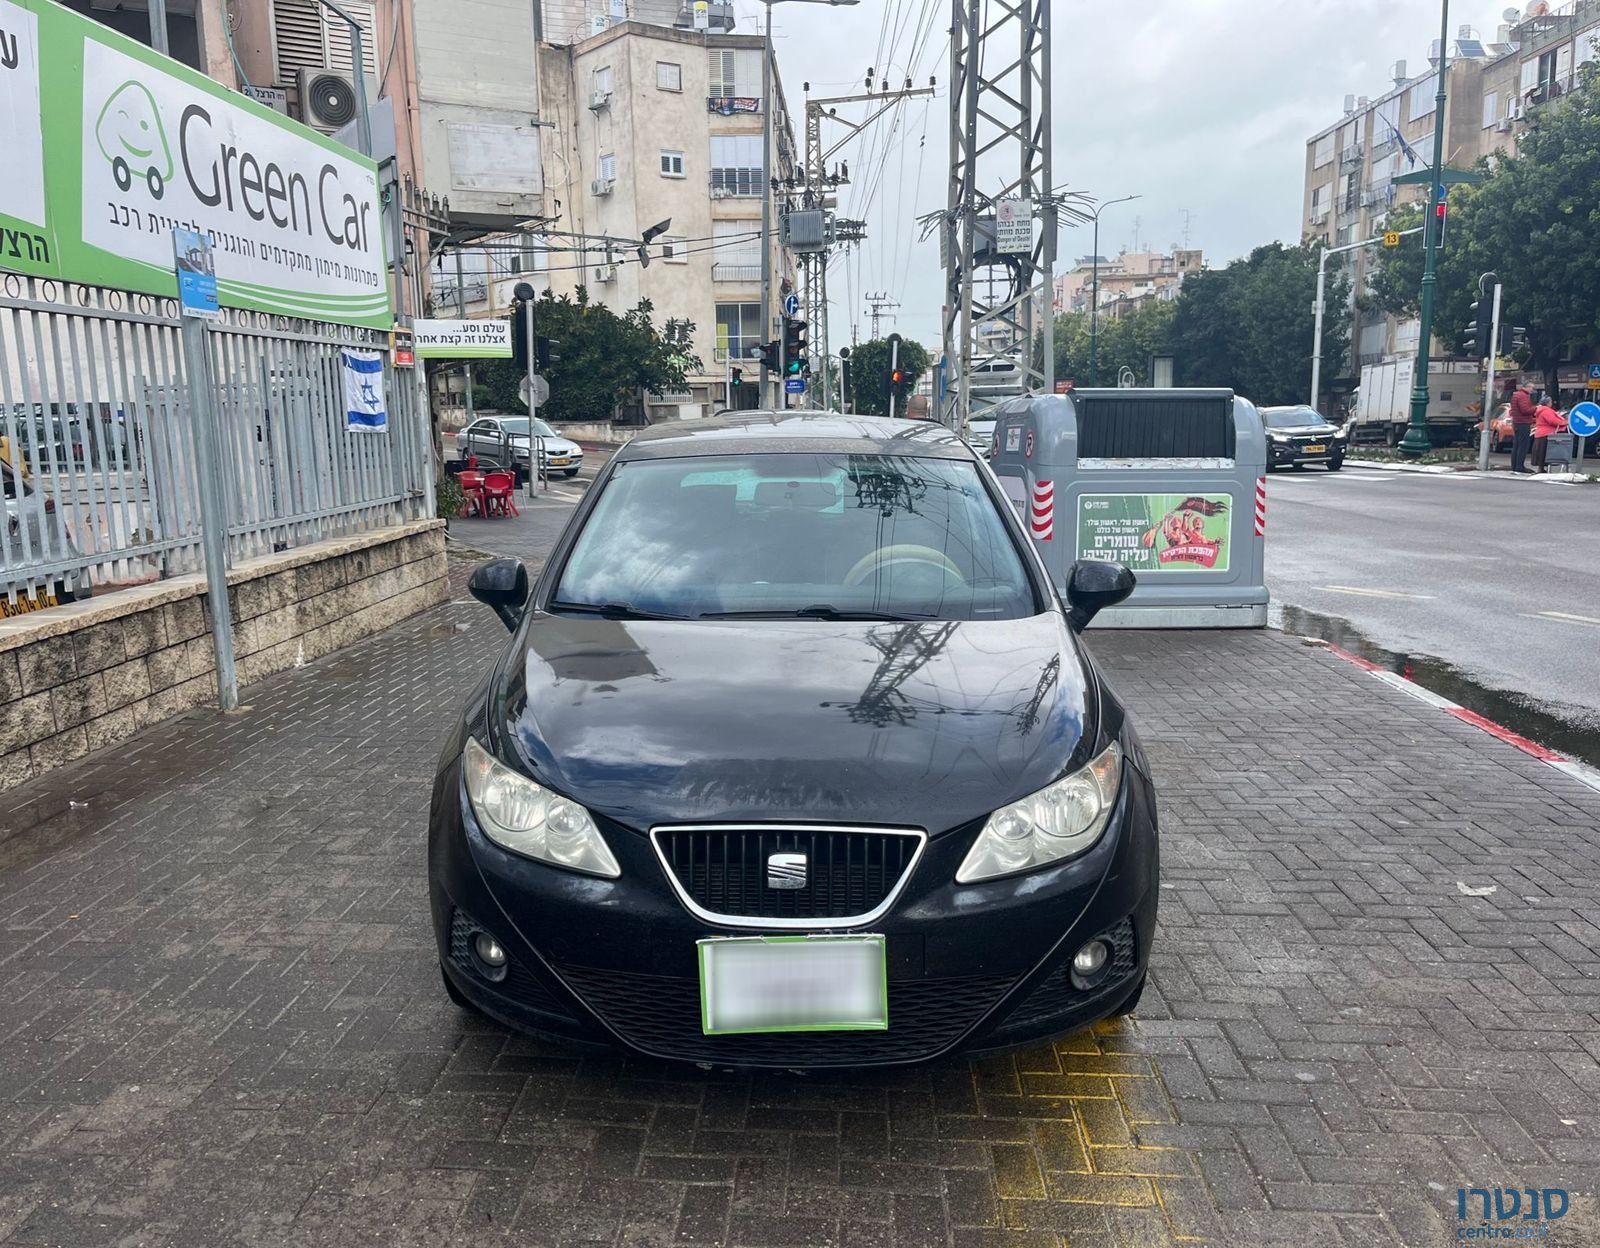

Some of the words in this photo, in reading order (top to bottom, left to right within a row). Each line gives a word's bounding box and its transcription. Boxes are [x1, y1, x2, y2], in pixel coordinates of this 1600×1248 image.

[255, 88, 275, 99] הרצל
[180, 104, 312, 236] Green
[318, 163, 370, 253] Car
[108, 202, 141, 230] רכב
[207, 229, 255, 258] והוגנים
[1386, 233, 1397, 244] 13
[260, 243, 312, 272] מתקדמים
[315, 257, 341, 278] מימון
[344, 264, 378, 287] פתרונות
[453, 324, 480, 333] וסע...
[483, 323, 505, 333] שלם
[415, 335, 437, 344] אחר
[440, 335, 461, 345] קצת
[465, 335, 475, 344] זה
[478, 334, 506, 344] אצלנו
[1094, 535, 1138, 548] שומרים
[1121, 548, 1149, 562] עליה
